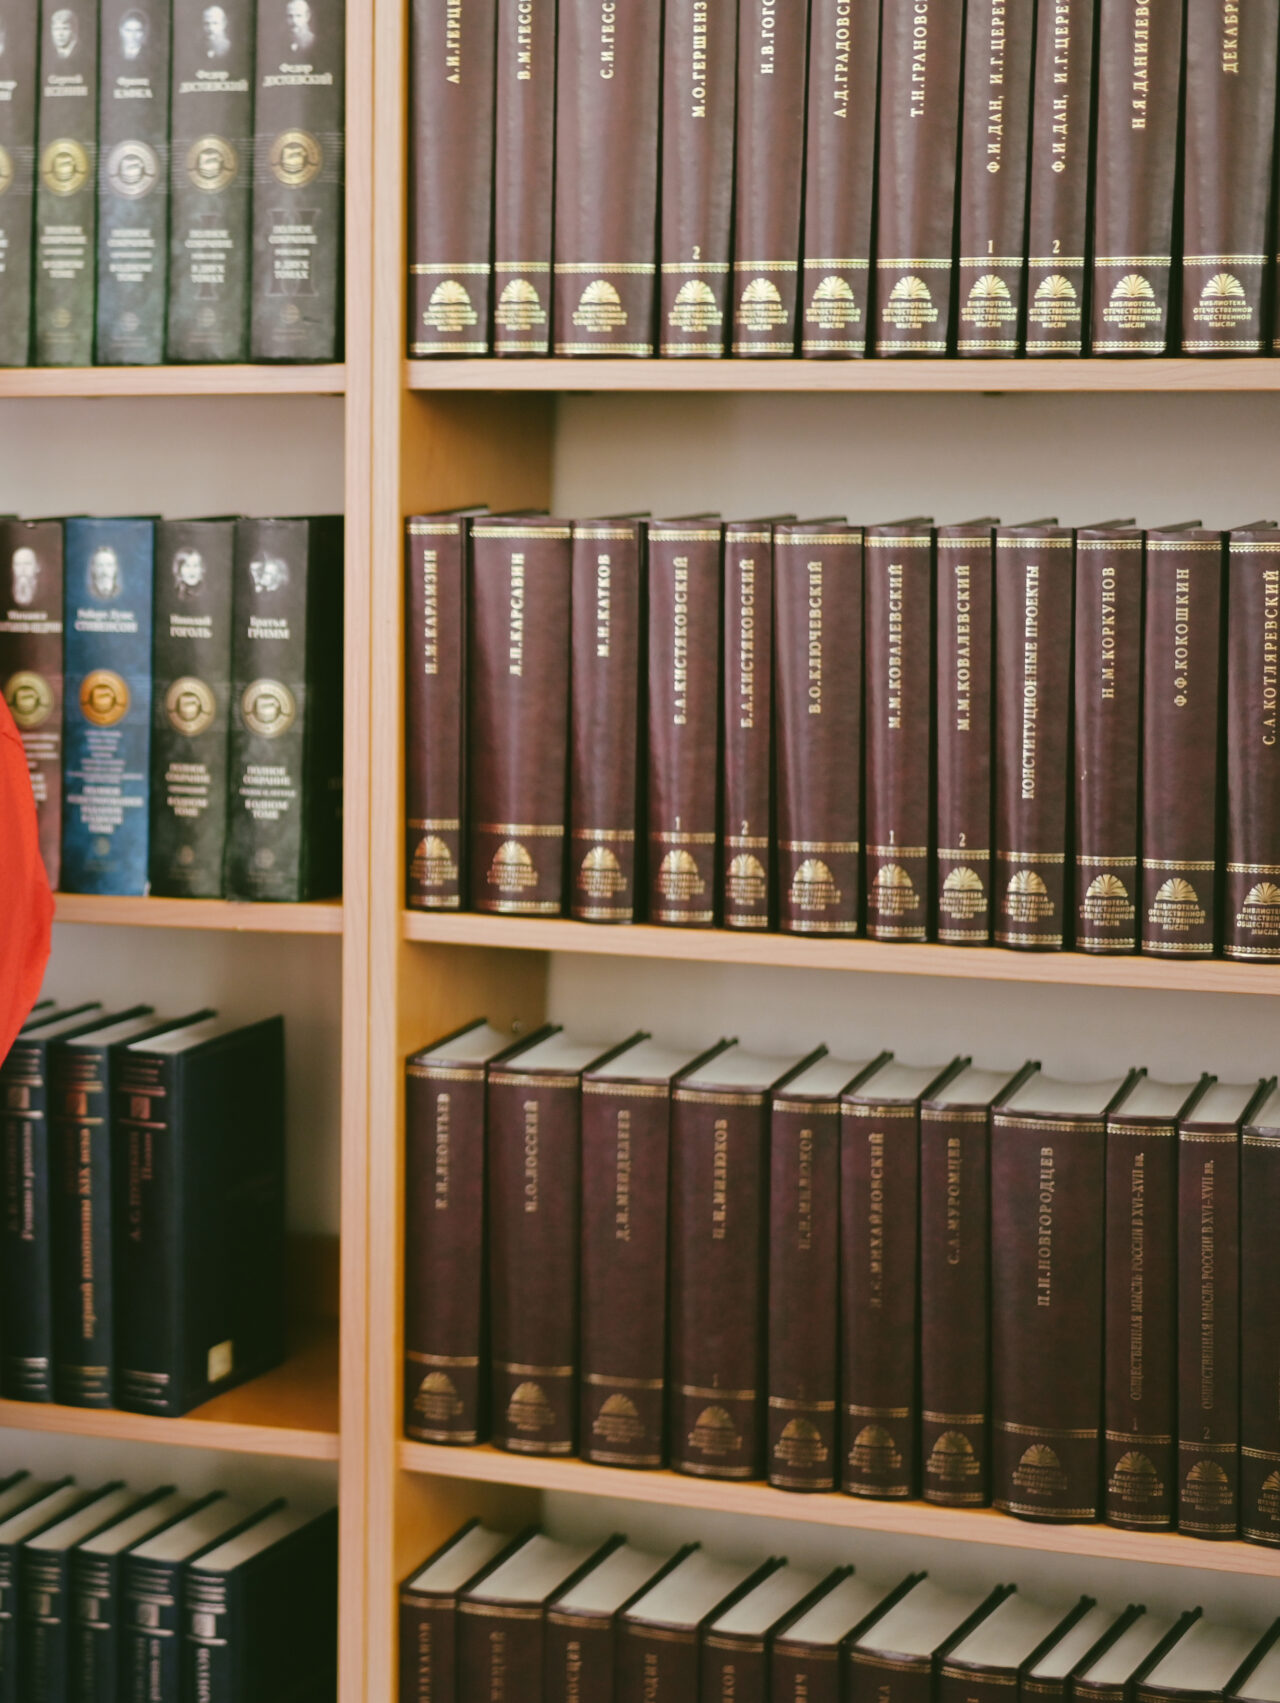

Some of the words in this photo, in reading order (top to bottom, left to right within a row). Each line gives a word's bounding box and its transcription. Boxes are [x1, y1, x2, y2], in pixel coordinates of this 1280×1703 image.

[517, 0, 531, 79] В.М.ГЕСС
[600, 0, 615, 79] С.И.ГЕСС
[692, 2, 706, 117] М.О.ГЕРШЕНЗ
[911, 0, 927, 117] Т.Н.ГРАНОВС
[987, 95, 1004, 173] Ф.И.ДАН,
[1052, 94, 1069, 172] Ф.И.ДАН,
[692, 246, 700, 259] 2
[988, 240, 993, 253] 1
[1053, 240, 1060, 253] 2
[1103, 314, 1161, 322] ОБЩЕСТВЕННОЙ
[171, 627, 212, 638] ГОГОЛЬ
[424, 550, 437, 673] Н.М.КАРАМЗИН
[510, 554, 524, 675] Л.П.КАРСАВИН
[598, 555, 610, 656] М.Н.КАТКОВ
[672, 557, 687, 724] Б.А.КИСТЯКОВСКИЙ
[739, 559, 754, 727] Б.А.КИСТЯКОВСКИЙ
[807, 562, 822, 713] В.О.КЛЮЧЕВСКИЙ
[887, 565, 902, 728] М.М.КОВАЛЕВСКИЙ
[955, 566, 969, 730] М.М.КОВАЛЕВСКИЙ
[1025, 566, 1038, 637] ПРОЕКТЫ
[1102, 568, 1115, 698] Н.М.КОРКУНОВ
[1174, 569, 1189, 706] Ф.Ф.КОКОШКИН
[1261, 571, 1278, 745] С.А.КОТЛЯРЕВСКИЙ
[1022, 642, 1037, 798] КОНСТИТУЦИОННЫЕ
[742, 821, 748, 835] 2
[890, 830, 894, 844] 1
[959, 833, 965, 847] 2
[1149, 916, 1204, 924] ОБЩЕСТВЕННОЙ
[1038, 1147, 1054, 1305] П.И.НОВГОРОДЦЕВ
